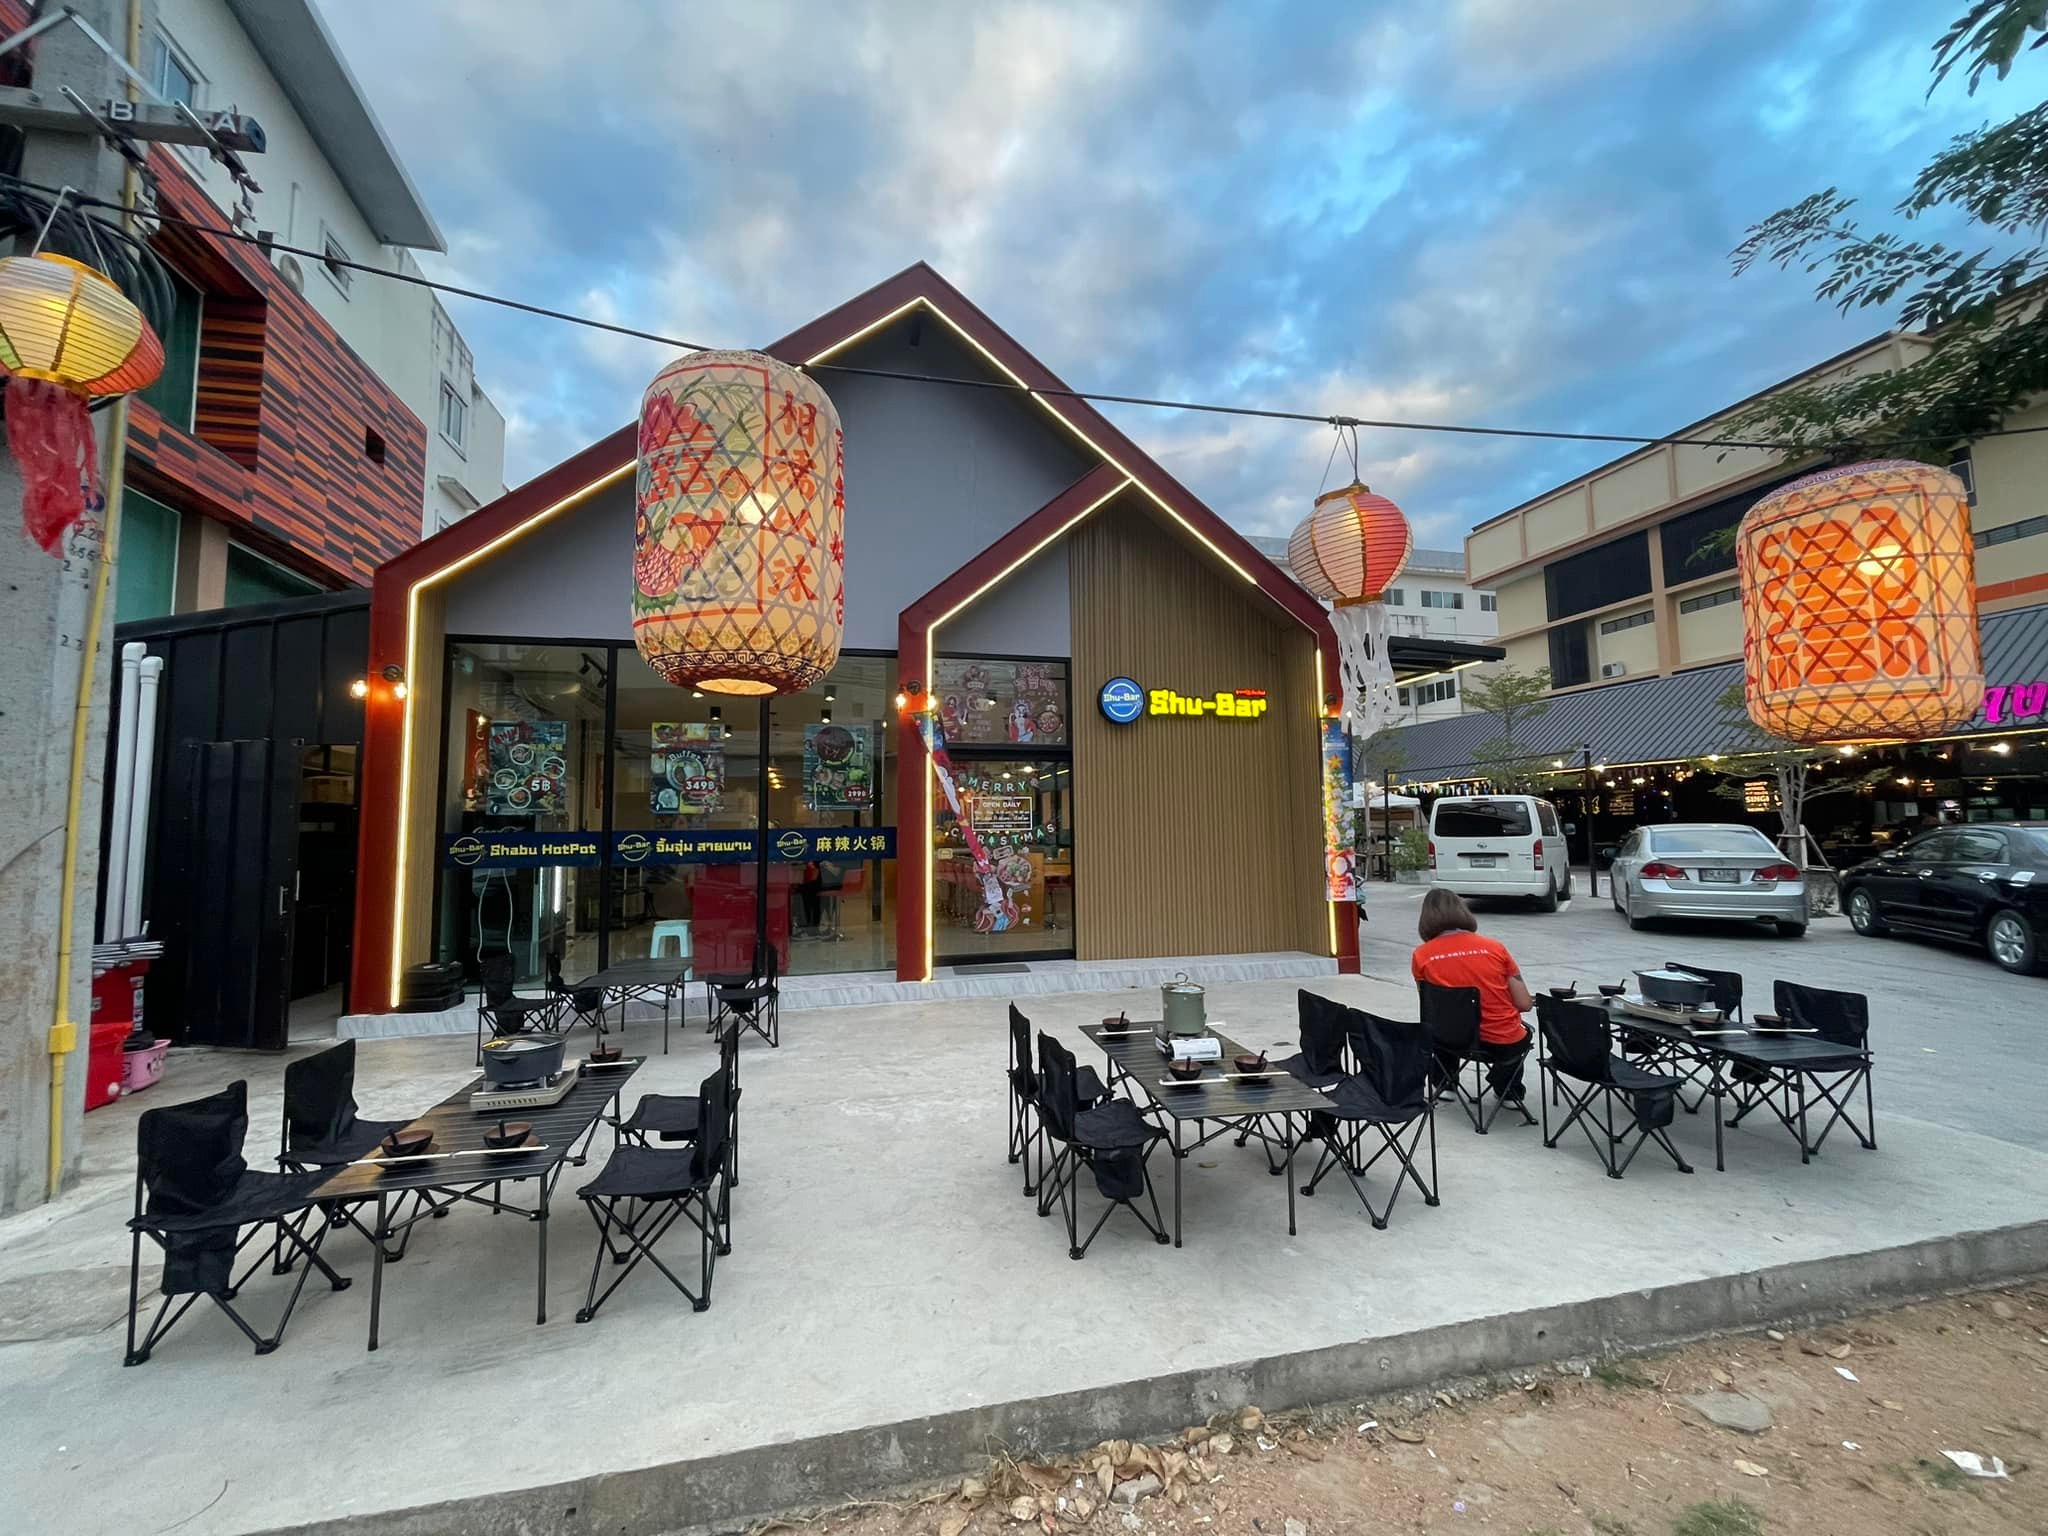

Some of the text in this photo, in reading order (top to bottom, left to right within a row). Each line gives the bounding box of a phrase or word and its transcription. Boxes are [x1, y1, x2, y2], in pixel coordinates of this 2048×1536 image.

[110, 101, 133, 121] B
[213, 112, 237, 133] A
[1103, 692, 1141, 702] Shu-Bar
[1149, 688, 1267, 718] Shu-Bar
[968, 776, 1026, 793] MERRY
[950, 822, 1056, 846] CRISTMAS
[449, 844, 485, 855] Shu-Bar
[489, 842, 598, 857] Shabu HotPot
[617, 841, 651, 852] Shu-Bar
[776, 838, 808, 848] Shu-Bar
[815, 834, 887, 852] 麻辣火锅
